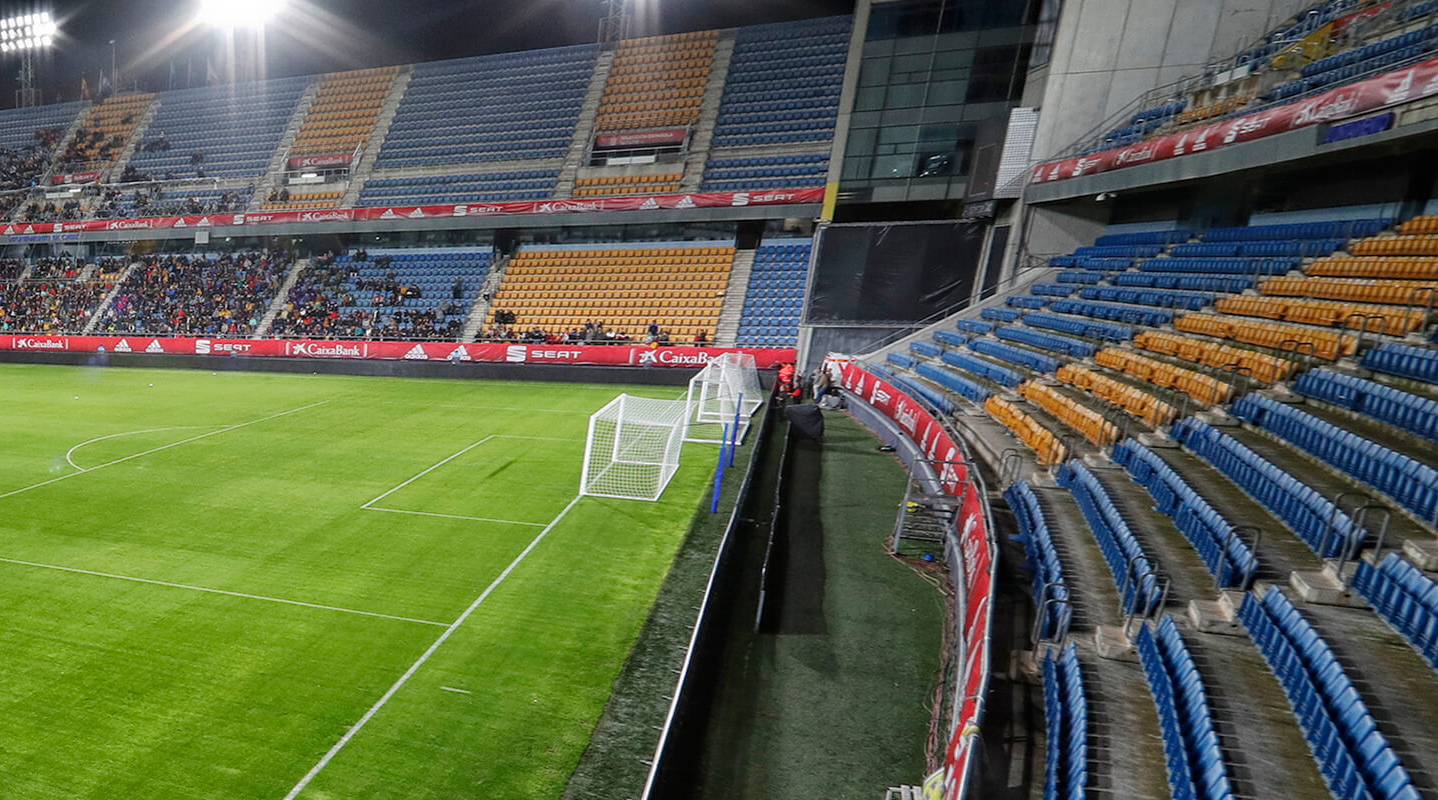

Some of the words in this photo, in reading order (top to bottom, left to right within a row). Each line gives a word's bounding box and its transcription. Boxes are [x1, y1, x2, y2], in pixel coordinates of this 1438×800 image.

[753, 193, 796, 202] SEAT
[469, 206, 503, 214] SEAT
[214, 343, 251, 351] SEAT
[307, 343, 360, 356] CaixaBank
[531, 350, 582, 359] SEAT
